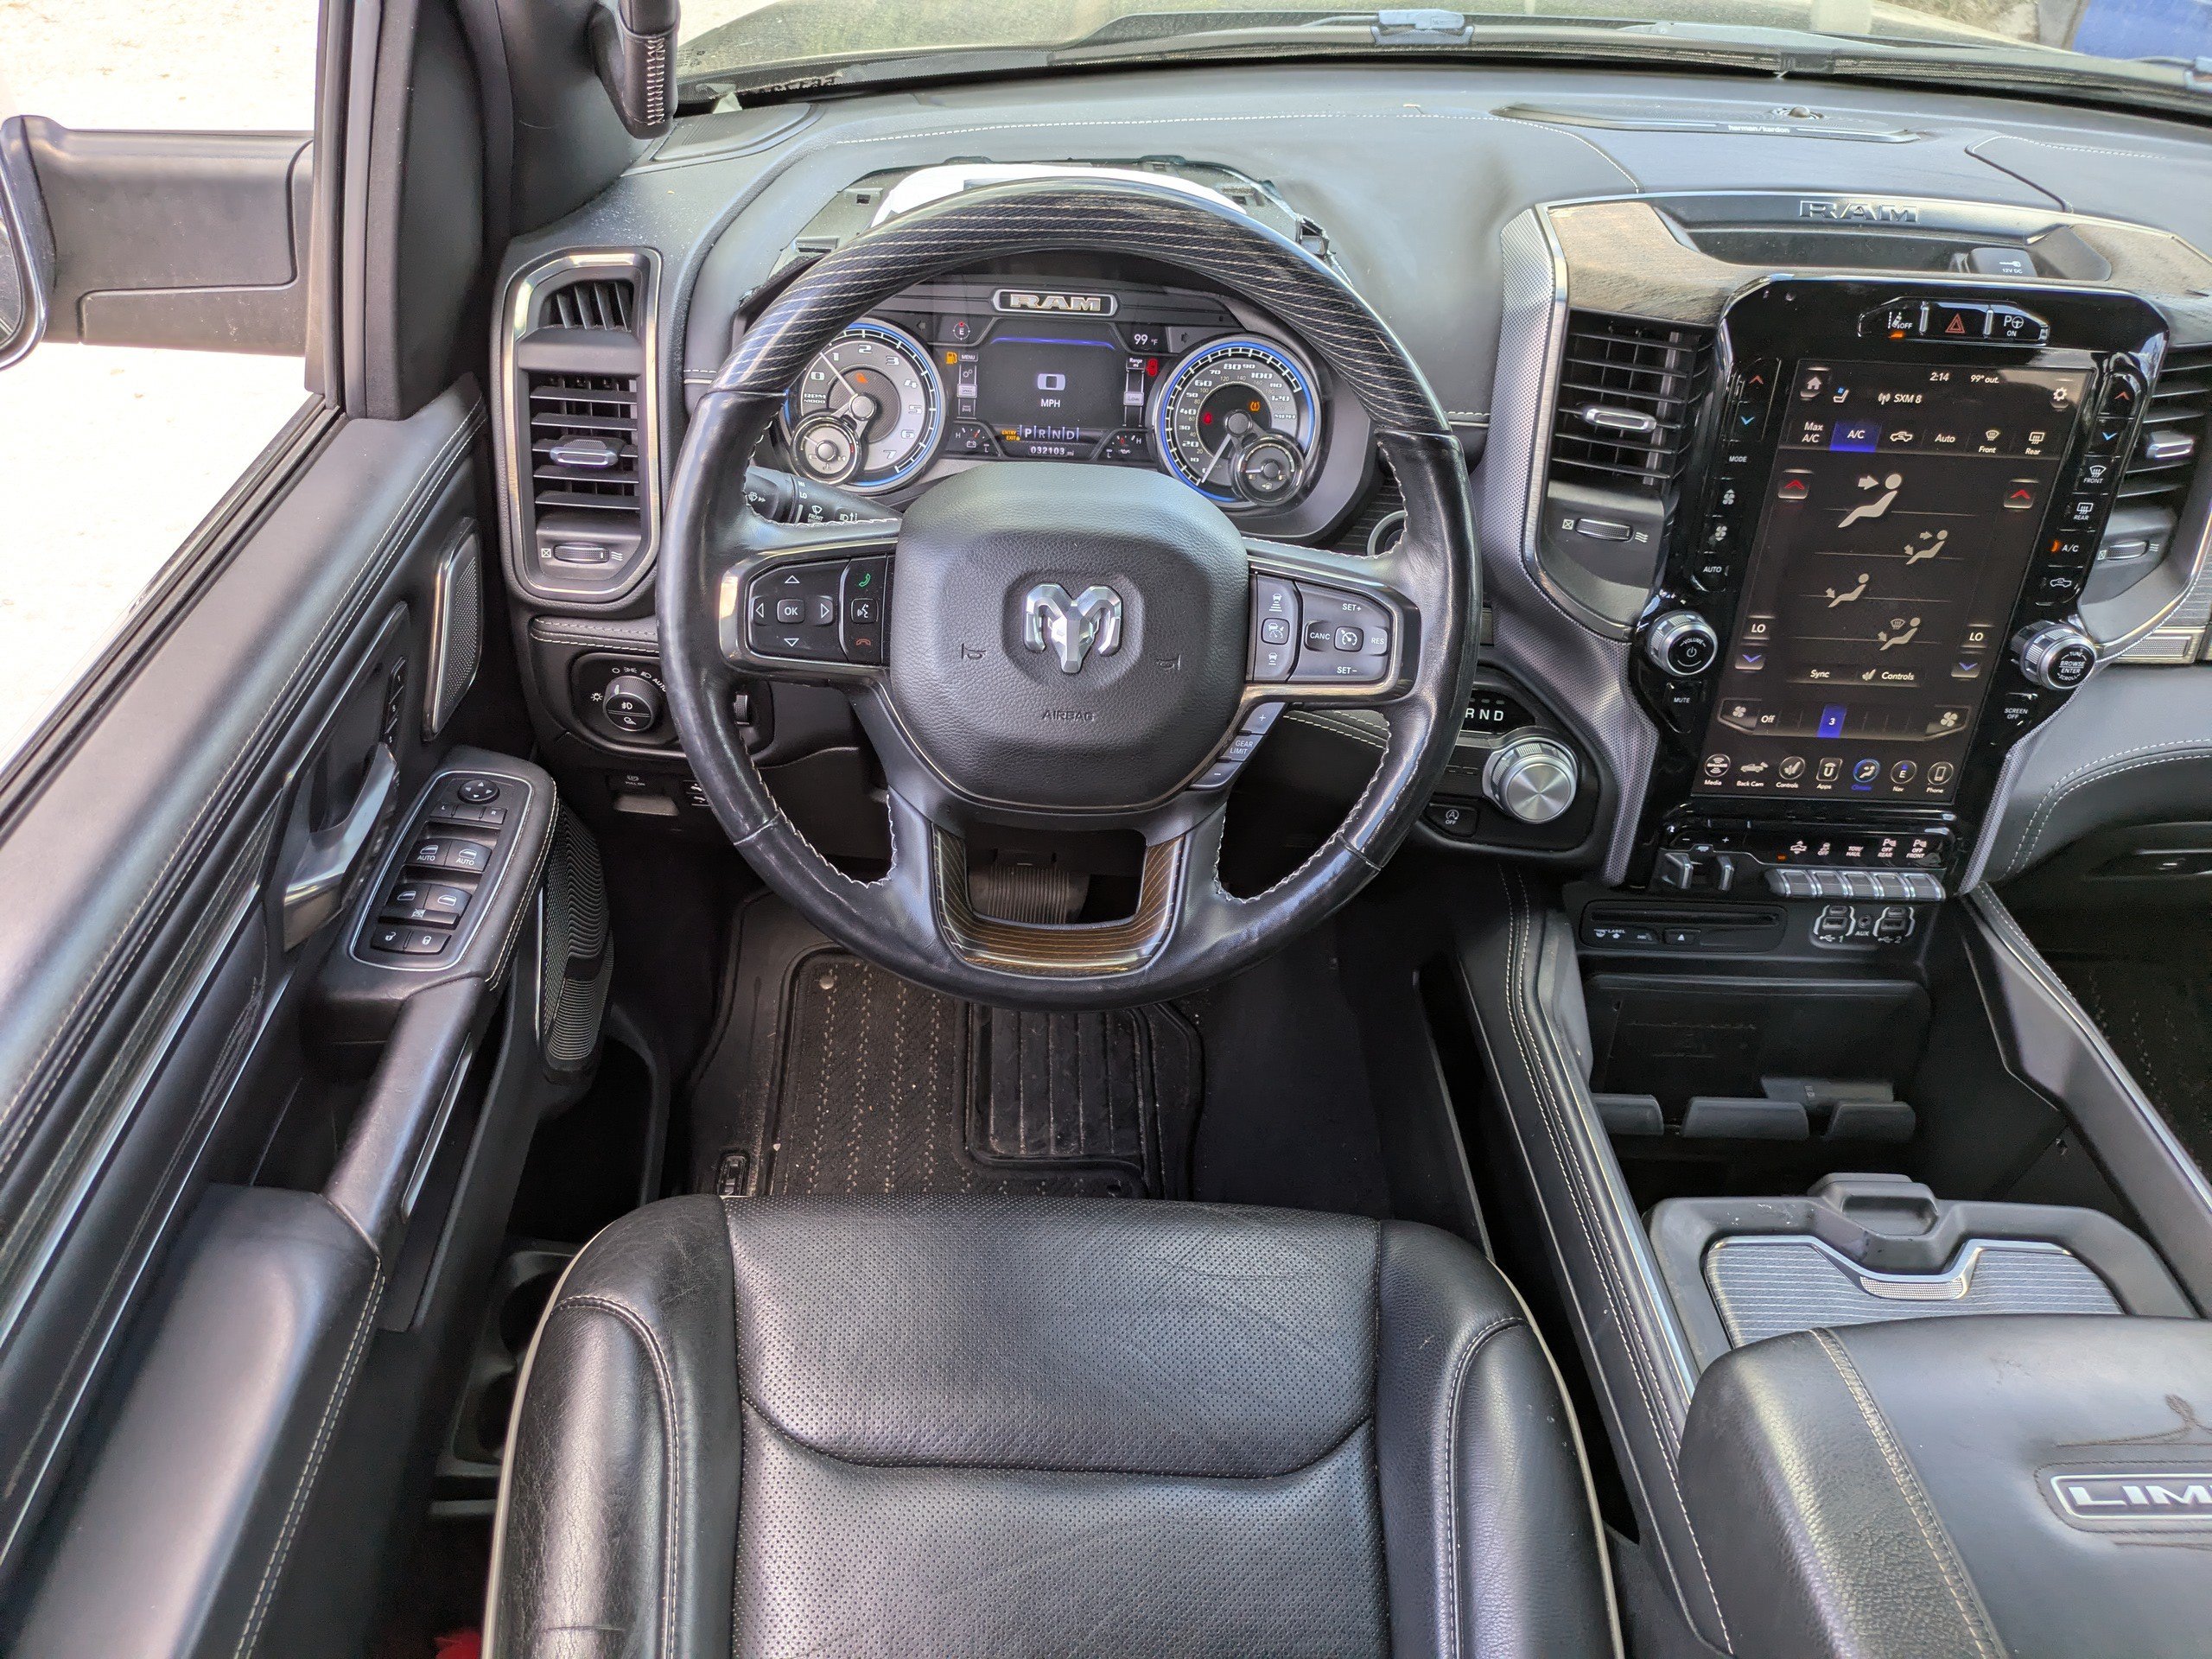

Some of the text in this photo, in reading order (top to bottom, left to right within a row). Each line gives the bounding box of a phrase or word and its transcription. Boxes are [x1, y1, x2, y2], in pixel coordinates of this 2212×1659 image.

[1728, 124, 1790, 133] harman/kardon
[1799, 200, 1919, 222] RAM
[1010, 294, 1102, 312] RAM
[1134, 334, 1147, 344] 99
[858, 345, 872, 354] 2
[832, 353, 840, 361] 1
[886, 355, 899, 365] 3
[810, 372, 824, 380] 0
[1929, 372, 1949, 382] 2:14
[1970, 374, 1985, 383] 99°
[904, 379, 918, 389] 4
[1037, 373, 1066, 391] 0
[1040, 398, 1061, 408] MPH
[1893, 394, 1922, 404] SXM 8
[908, 405, 922, 414] 5
[1804, 421, 1824, 431] Max
[900, 429, 915, 439] 6
[1025, 428, 1075, 440] P R N D
[1802, 434, 1820, 443] A/C
[1847, 429, 1866, 439] A/C
[1935, 434, 1955, 443] Auto
[883, 449, 897, 459] 7
[1031, 446, 1065, 455] 032103
[799, 491, 808, 499] LO
[784, 607, 798, 616] OK
[1751, 624, 1766, 633] LO
[1310, 632, 1331, 640] CANC
[1968, 632, 1984, 641] LO
[1810, 669, 1830, 679] Sync
[1881, 671, 1915, 681] Controls
[1041, 709, 1096, 722] AIRBAG
[1465, 708, 1504, 721] R N D
[2005, 707, 2028, 715] SCREEN
[1760, 715, 1776, 723] Off
[2068, 1485, 2212, 1505] LIM
